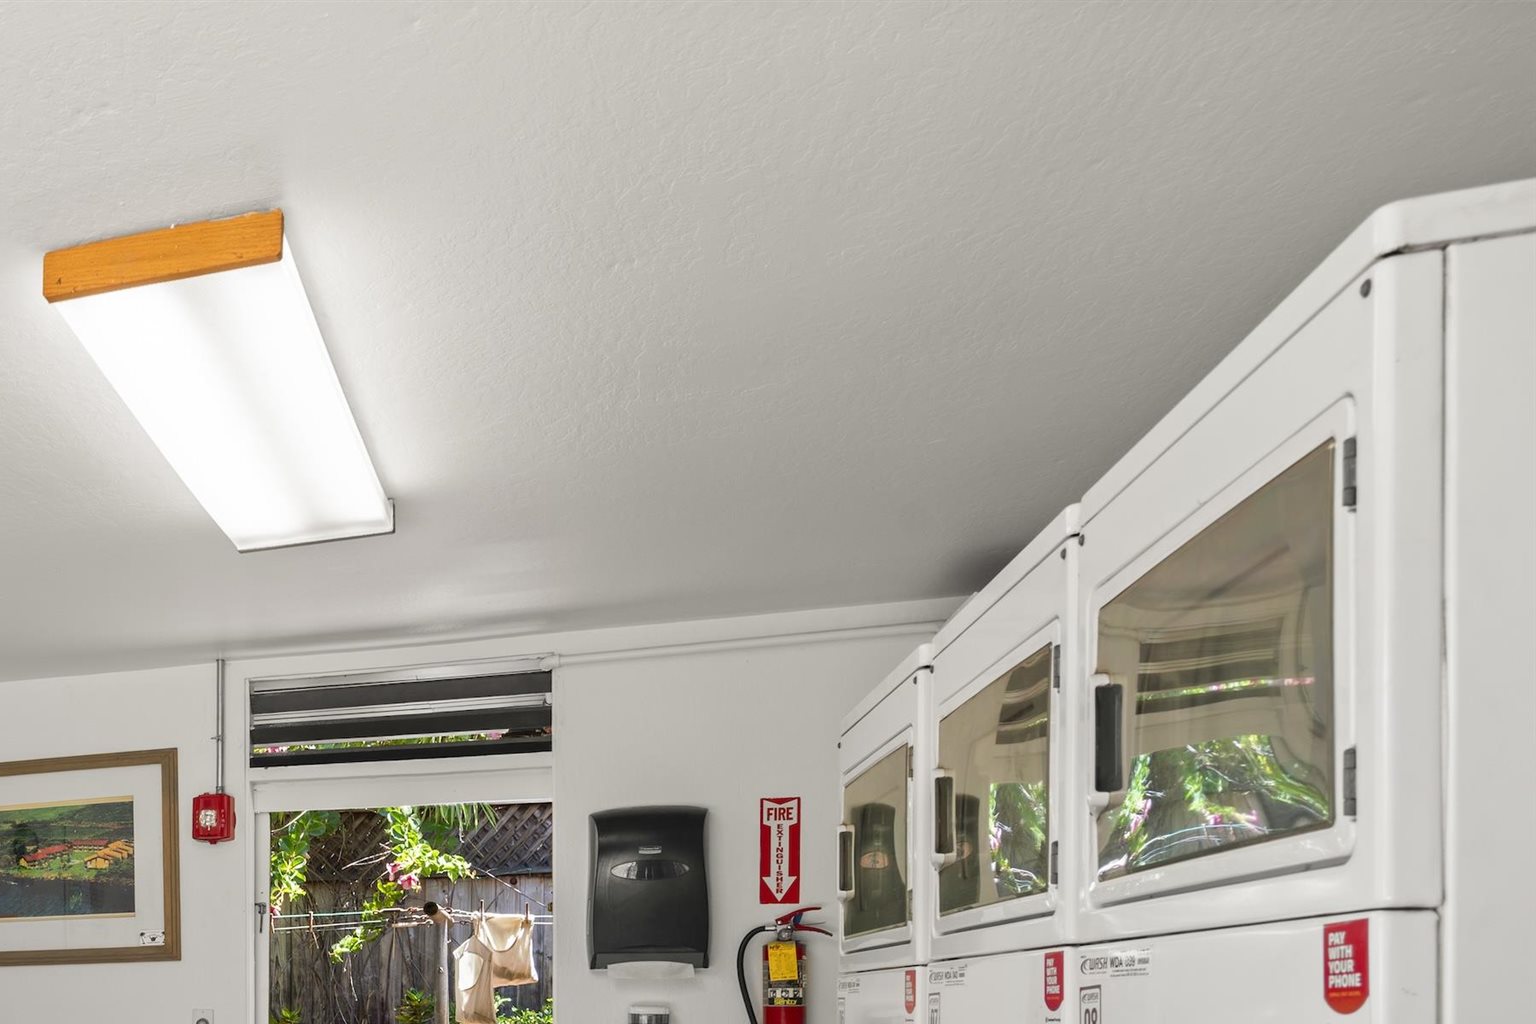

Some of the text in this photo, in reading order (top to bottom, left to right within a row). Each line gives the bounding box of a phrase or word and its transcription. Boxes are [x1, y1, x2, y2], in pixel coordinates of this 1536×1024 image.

[767, 807, 793, 821] FIRE
[1328, 931, 1346, 946] PAY
[1328, 944, 1353, 960] WITH
[1328, 959, 1354, 974] YOUR
[1328, 972, 1362, 989] PHONE
